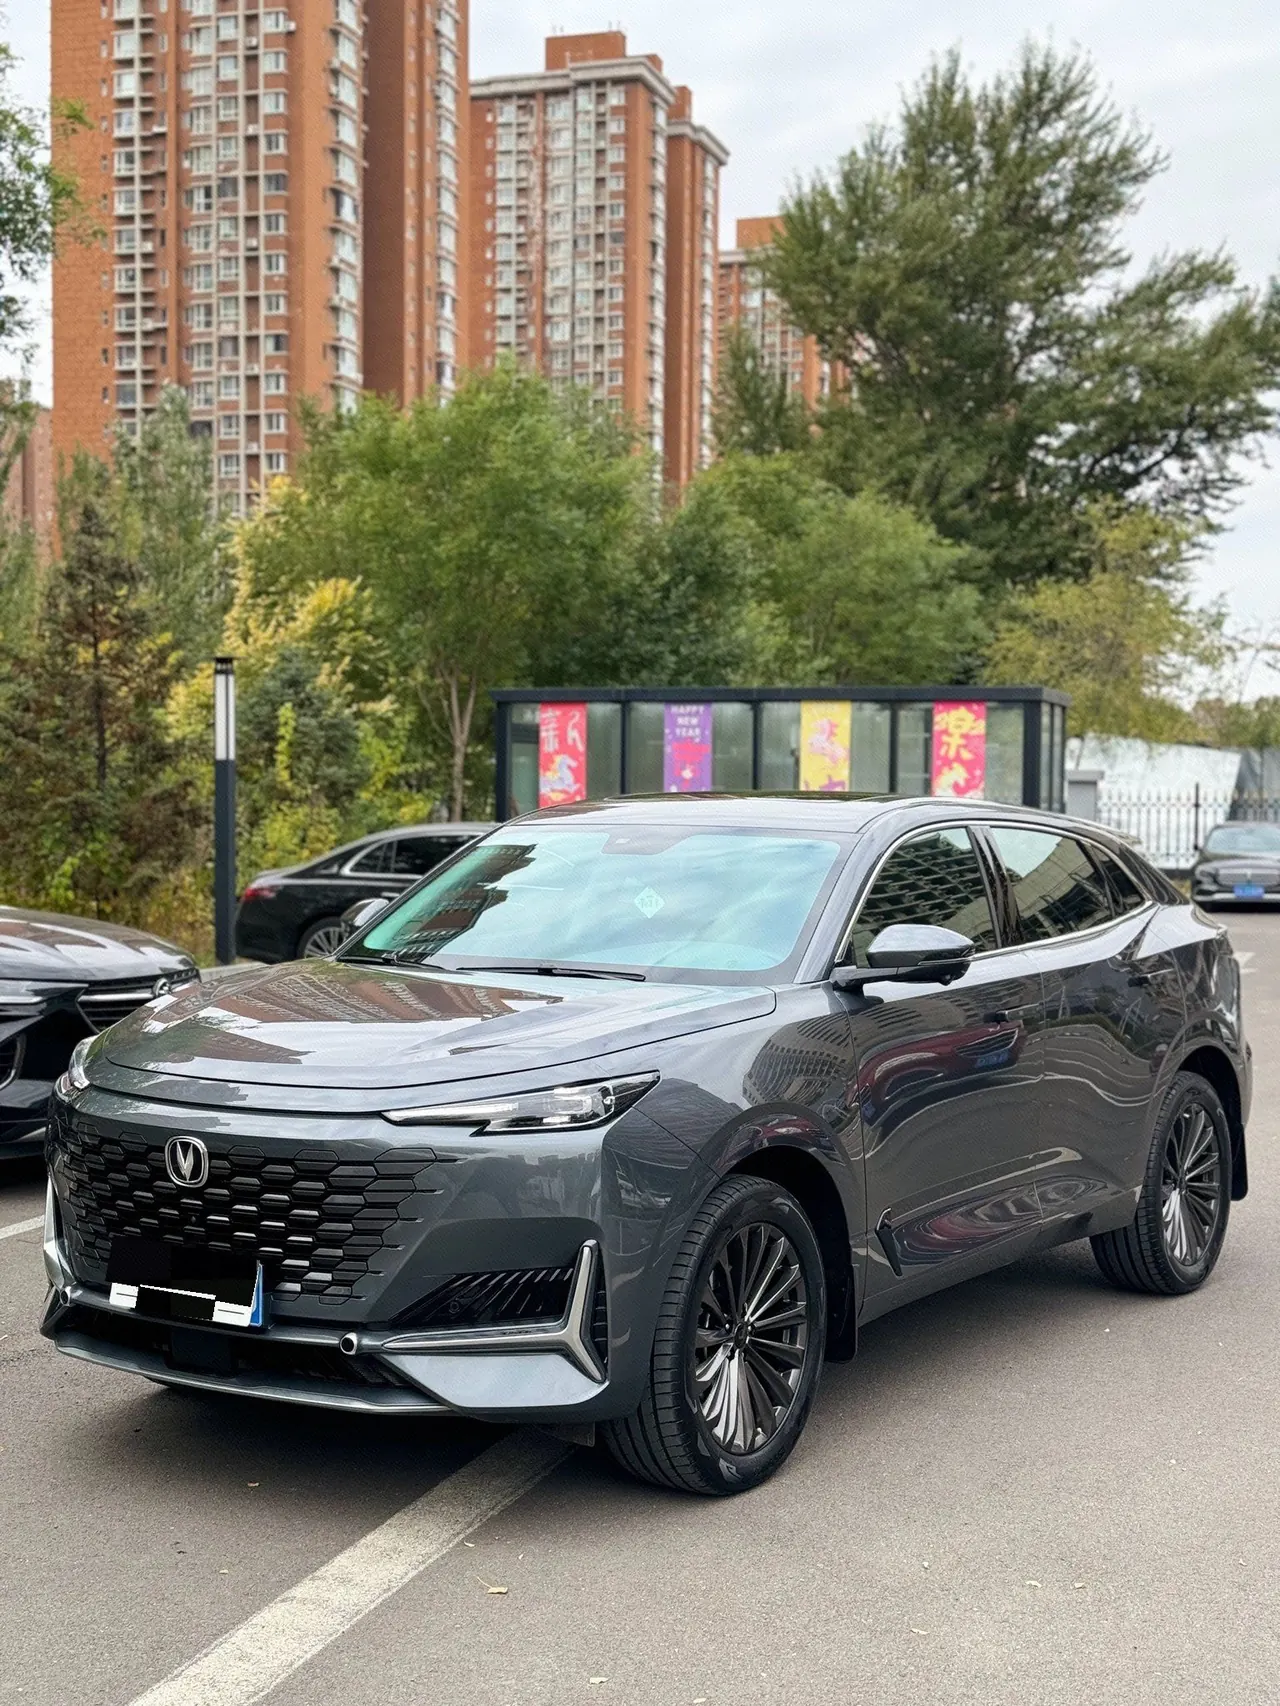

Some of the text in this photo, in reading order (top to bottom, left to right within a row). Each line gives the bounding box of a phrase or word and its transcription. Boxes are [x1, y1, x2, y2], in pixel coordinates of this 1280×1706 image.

[671, 704, 704, 714] HAPPY
[677, 716, 699, 725] NEW
[675, 727, 701, 737] YEAR
